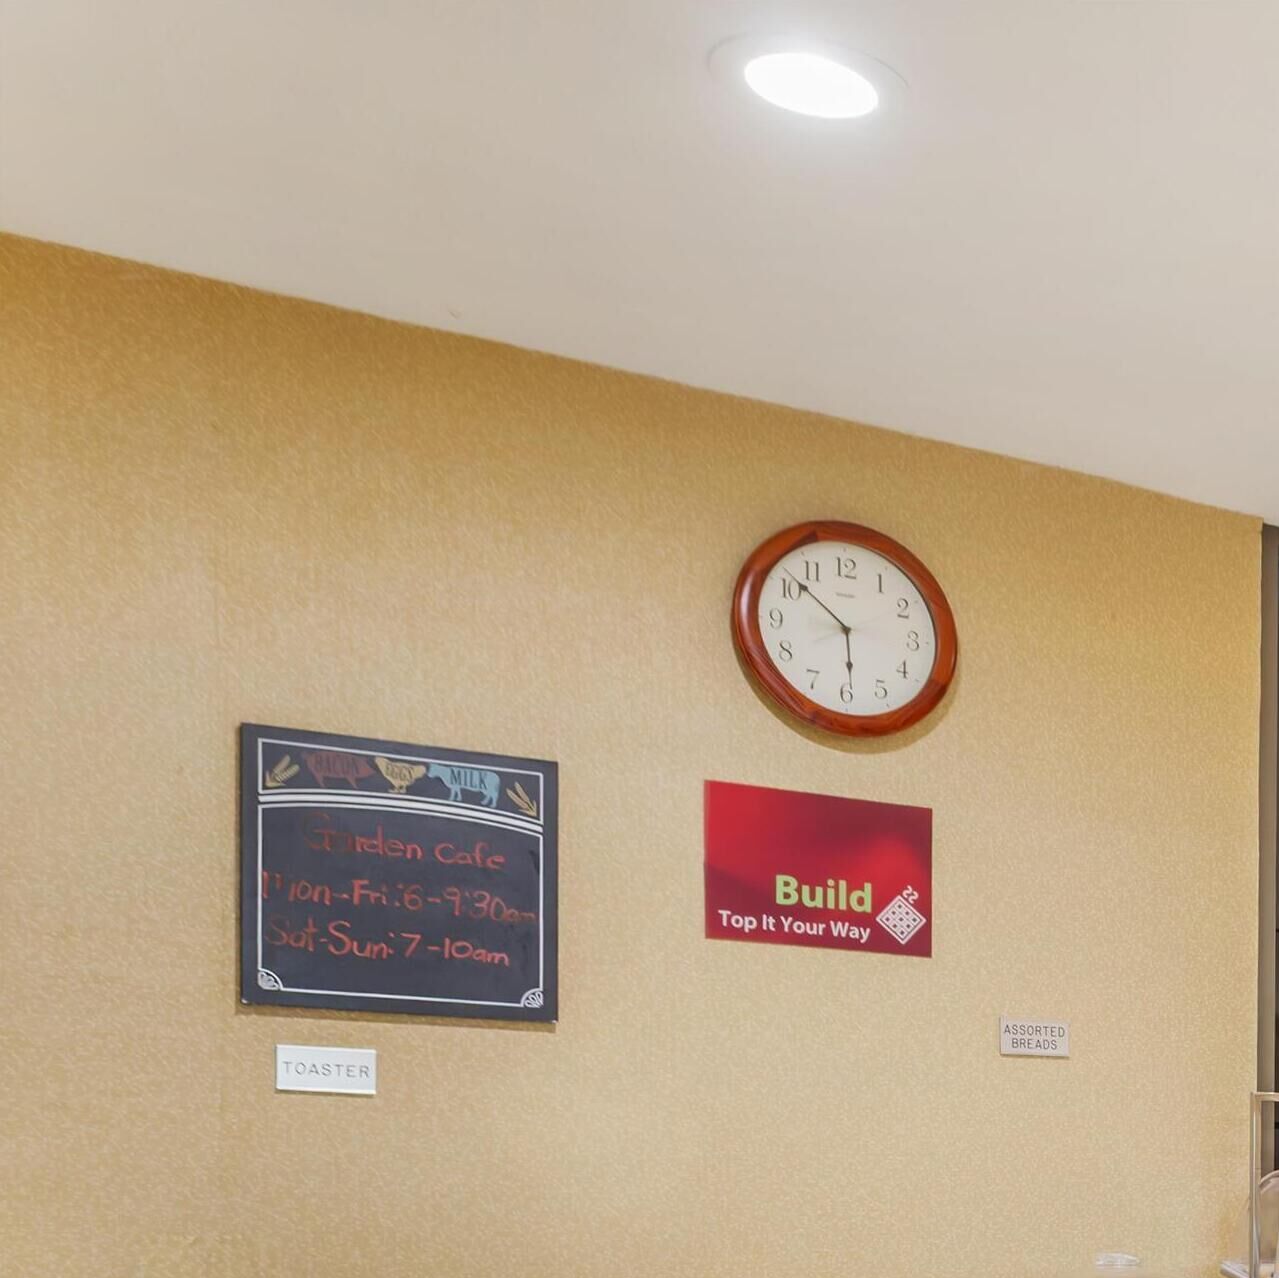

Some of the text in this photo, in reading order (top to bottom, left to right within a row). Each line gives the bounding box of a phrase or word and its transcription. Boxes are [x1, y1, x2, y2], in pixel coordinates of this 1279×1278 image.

[804, 560, 820, 582] 11
[836, 556, 857, 579] 12
[782, 578, 802, 600] 10
[877, 573, 884, 593] 1
[769, 608, 783, 629] 9
[896, 598, 909, 619] 2
[779, 640, 793, 662] 8
[906, 631, 920, 651] 3
[806, 668, 820, 690] 7
[896, 660, 909, 679] 4
[839, 683, 853, 703] 6
[874, 679, 888, 700] 5
[385, 763, 414, 783] EGGS
[450, 767, 488, 790] MILK
[434, 841, 506, 870] Cafe
[775, 874, 872, 913] Build
[718, 909, 870, 943] Top It Your Way
[1004, 1024, 1065, 1038] ASSORTED
[1011, 1038, 1057, 1050] BREADS
[282, 1061, 370, 1078] TOASTER
